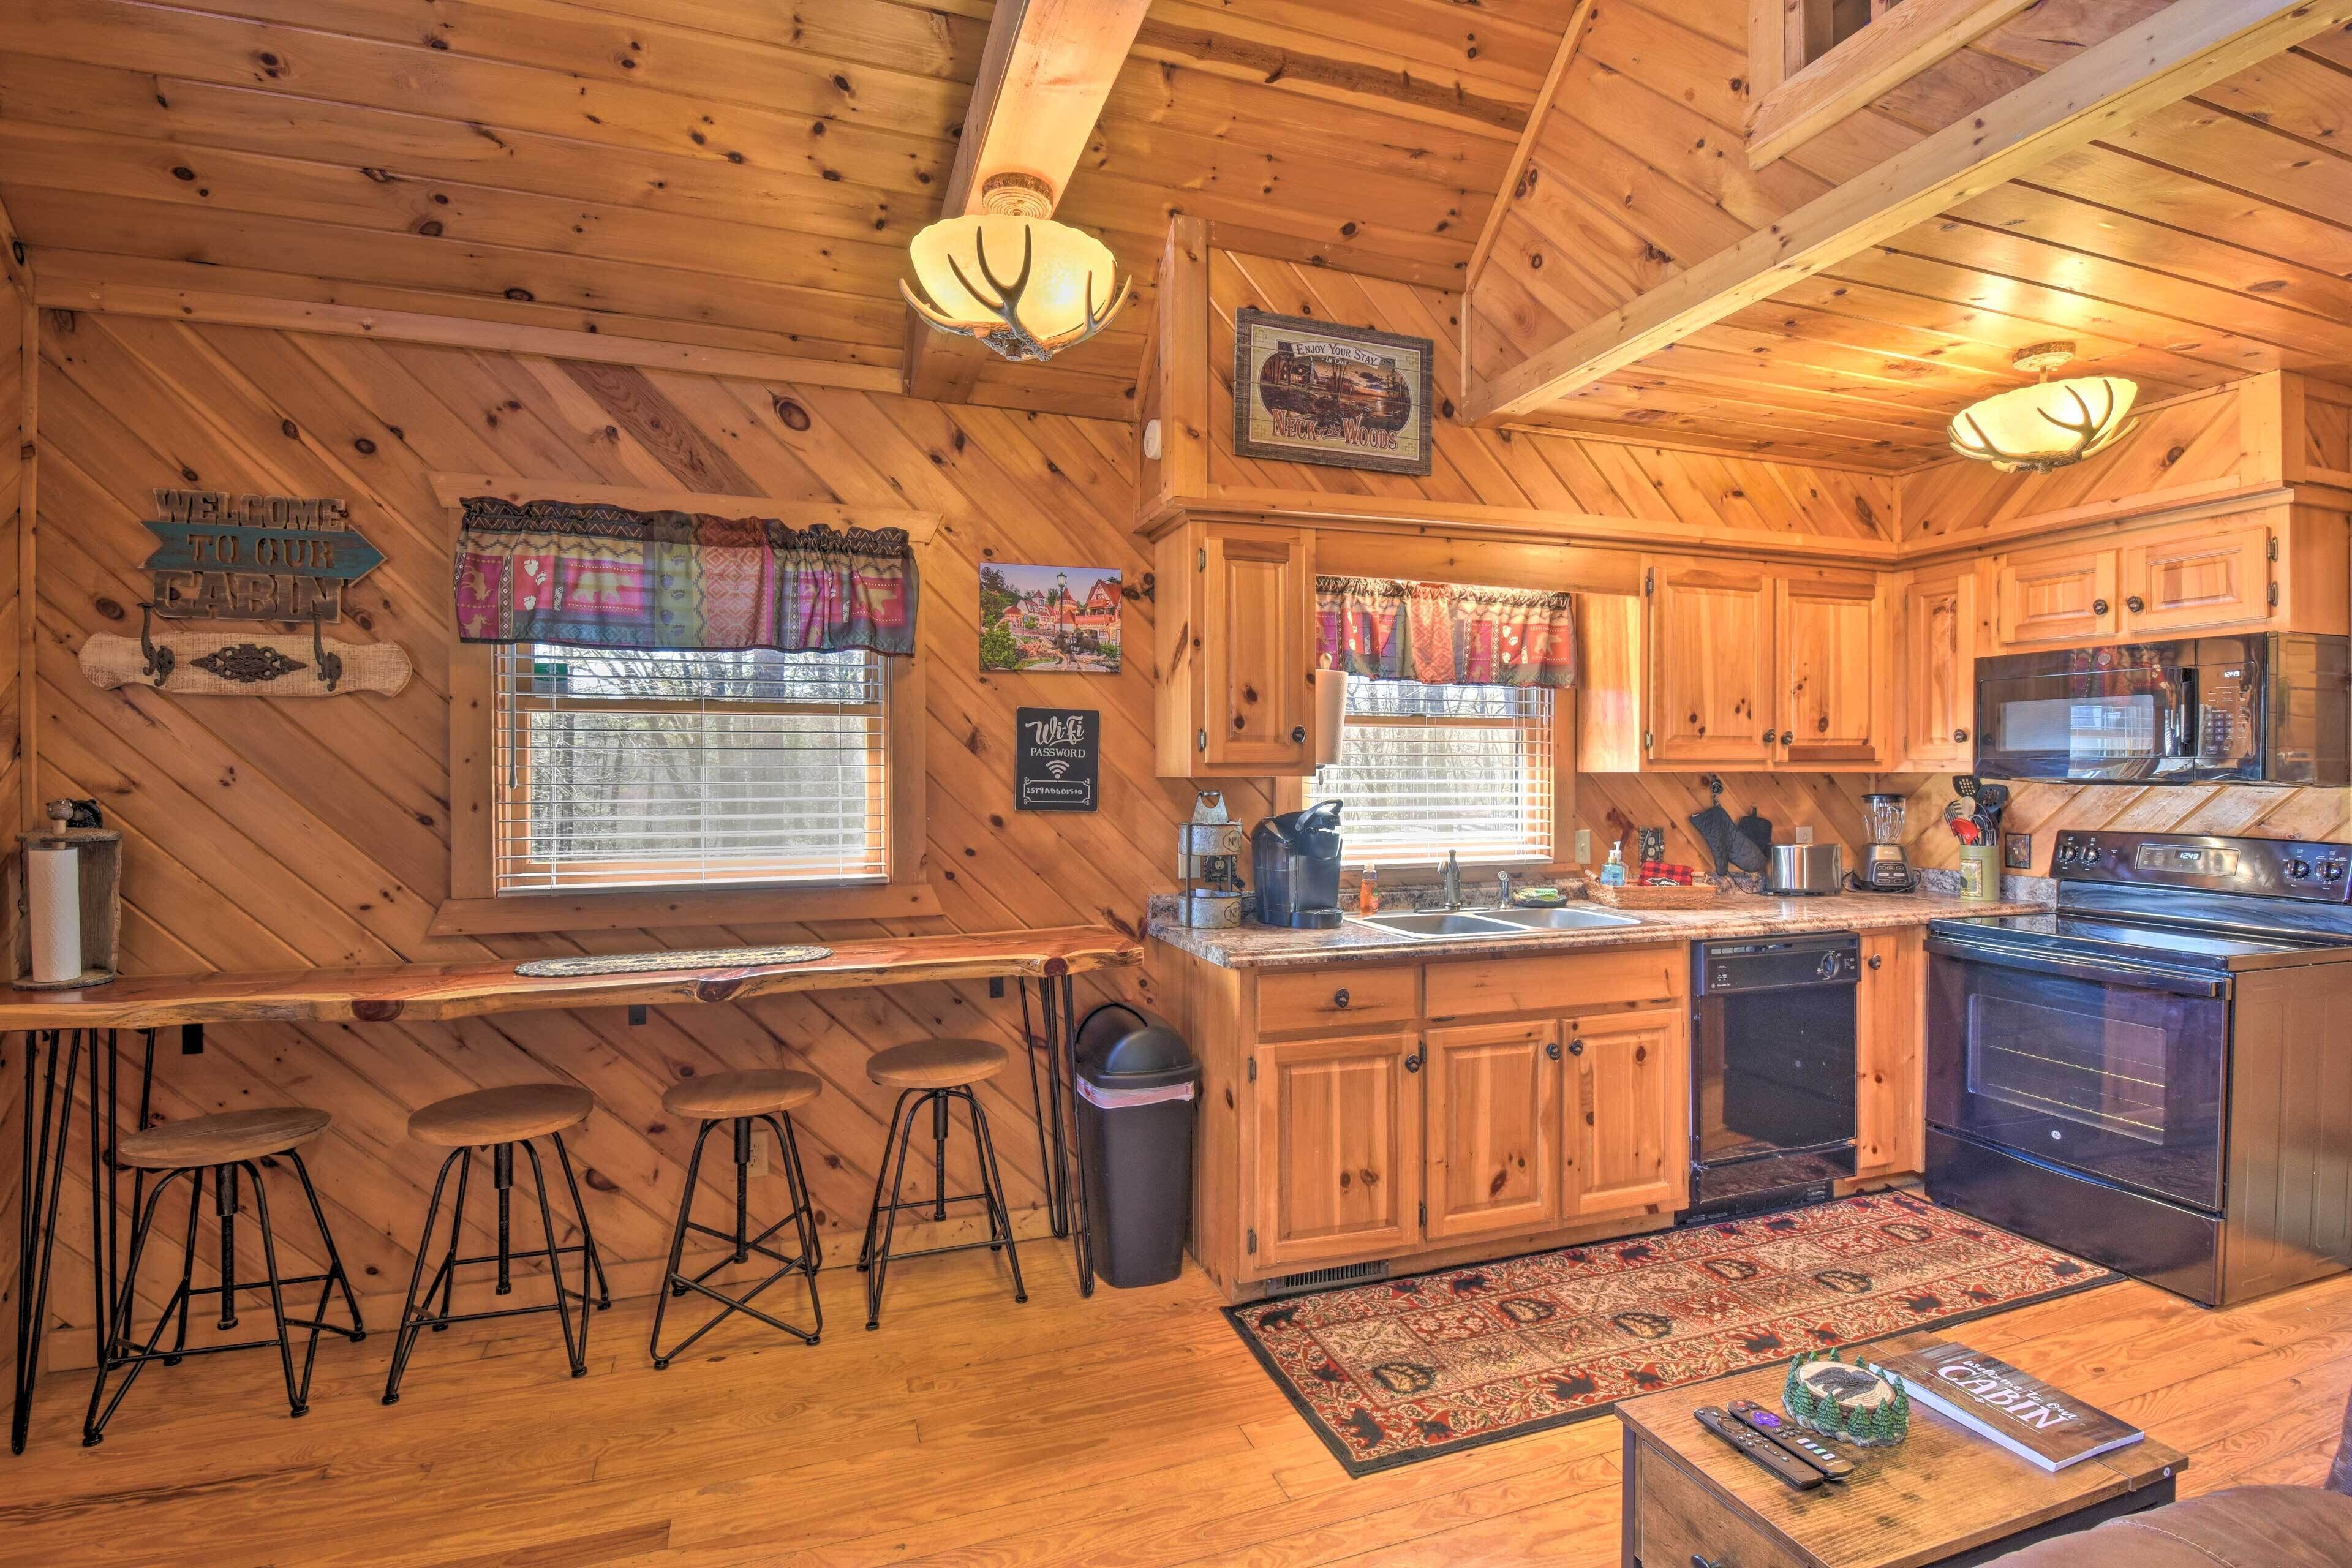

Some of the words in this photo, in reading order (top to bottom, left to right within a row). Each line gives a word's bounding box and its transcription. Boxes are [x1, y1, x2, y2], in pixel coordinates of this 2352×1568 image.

[1297, 344, 1326, 353] ENJOY
[1329, 344, 1351, 357] YOUR
[1354, 349, 1378, 364] STAY
[1272, 409, 1318, 441] NECK
[1341, 413, 1399, 450] WOODS
[153, 488, 347, 532] WELCOME
[187, 534, 241, 564] TO
[255, 538, 335, 568] OUR
[153, 571, 344, 624] CABIN
[1030, 748, 1086, 758] PASSWORD
[1937, 1365, 2070, 1429] CABIN
[1962, 1360, 2022, 1391] welcome
[2026, 1390, 2043, 1402] to
